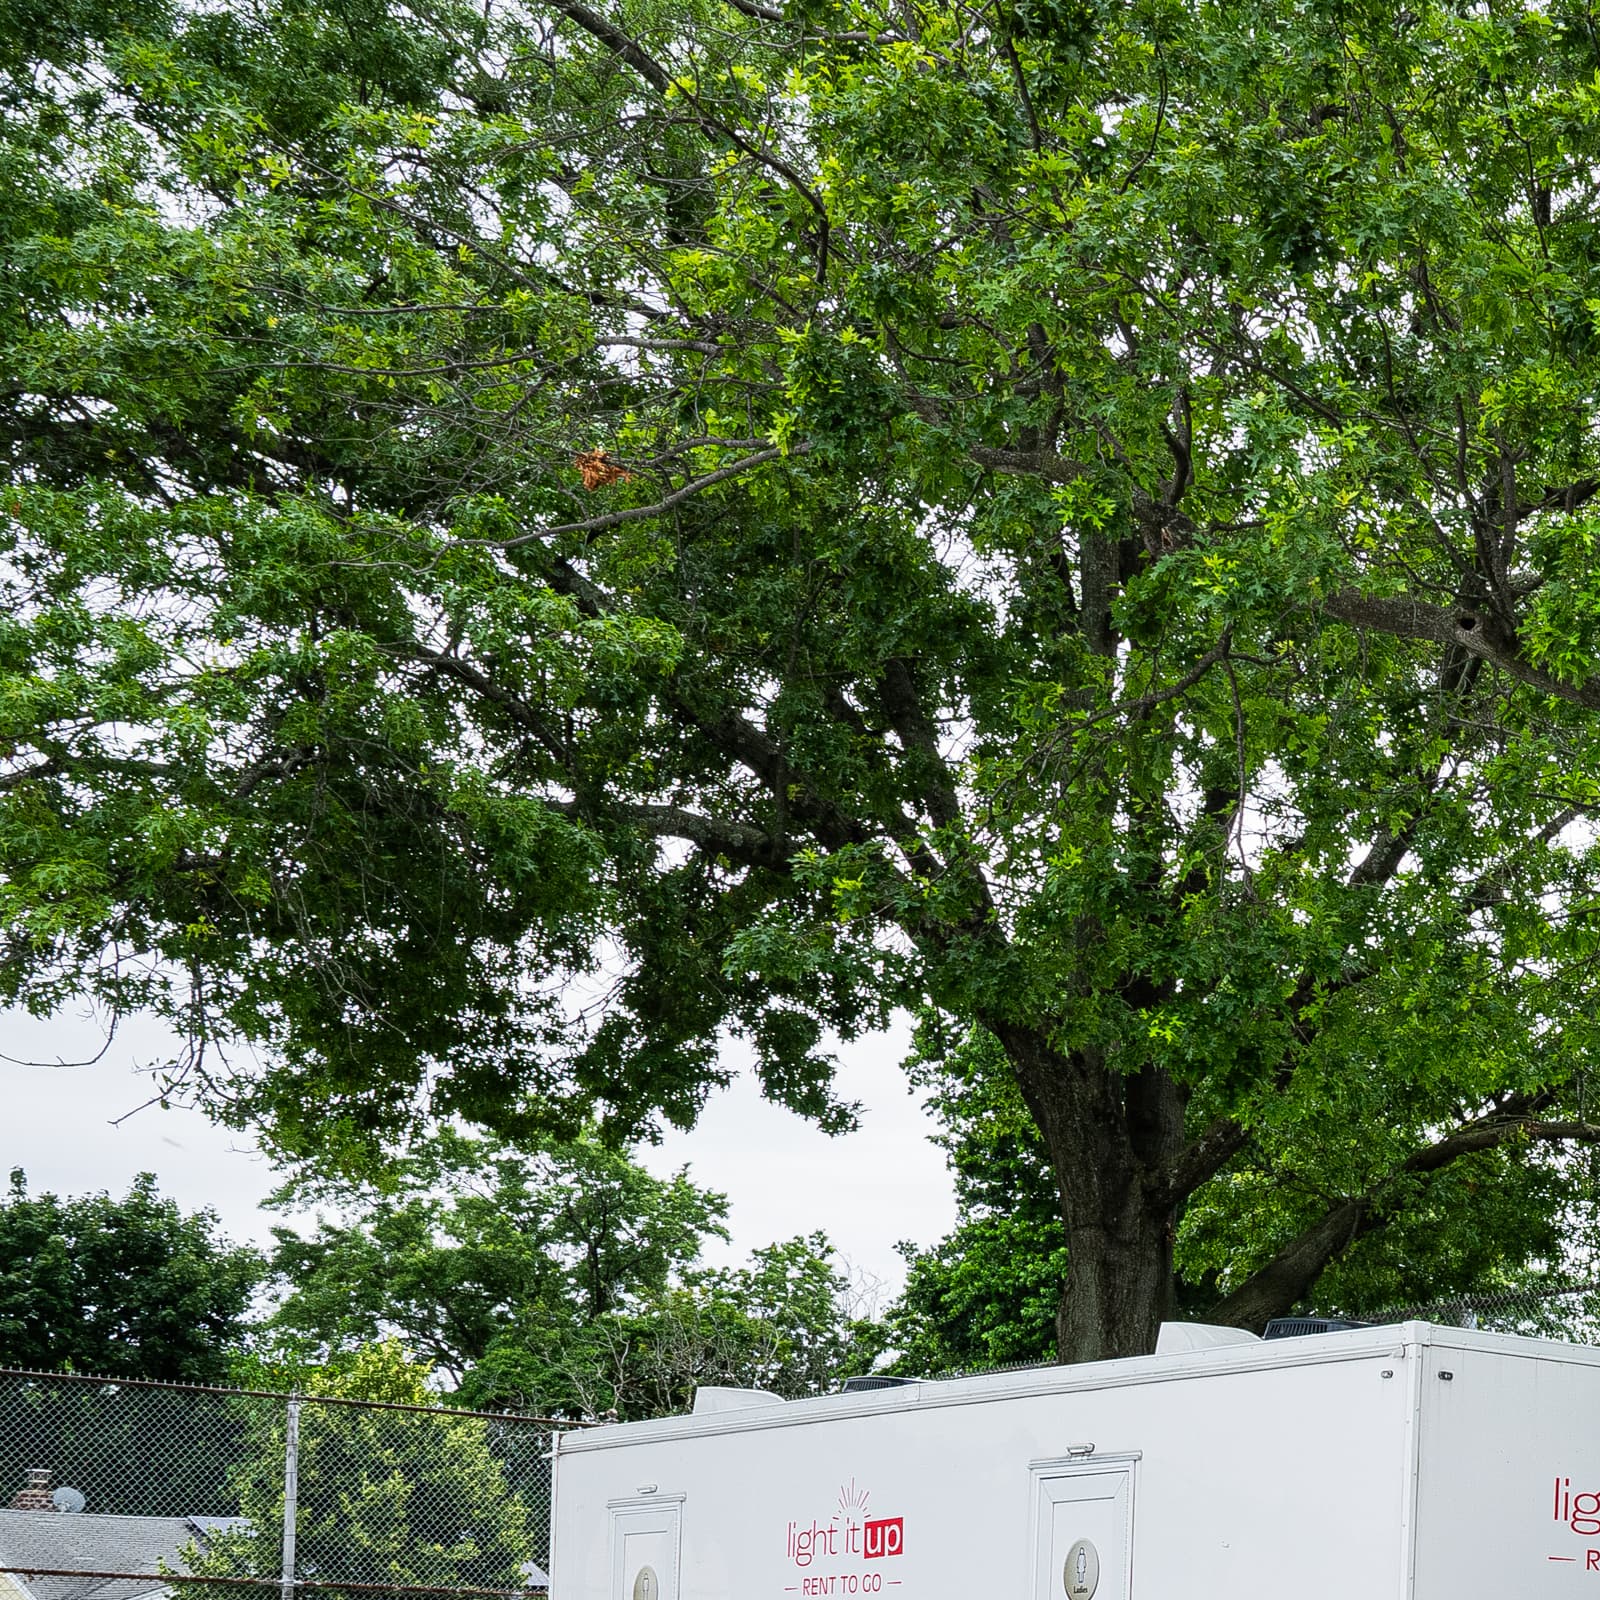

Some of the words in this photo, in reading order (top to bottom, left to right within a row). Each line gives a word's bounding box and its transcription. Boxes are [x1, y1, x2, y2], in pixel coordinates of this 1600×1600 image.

[787, 1519, 838, 1567] light
[845, 1516, 860, 1554] it
[866, 1523, 901, 1557] up
[802, 1576, 837, 1596] RENT
[840, 1575, 858, 1594] TO
[862, 1573, 882, 1593] GO
